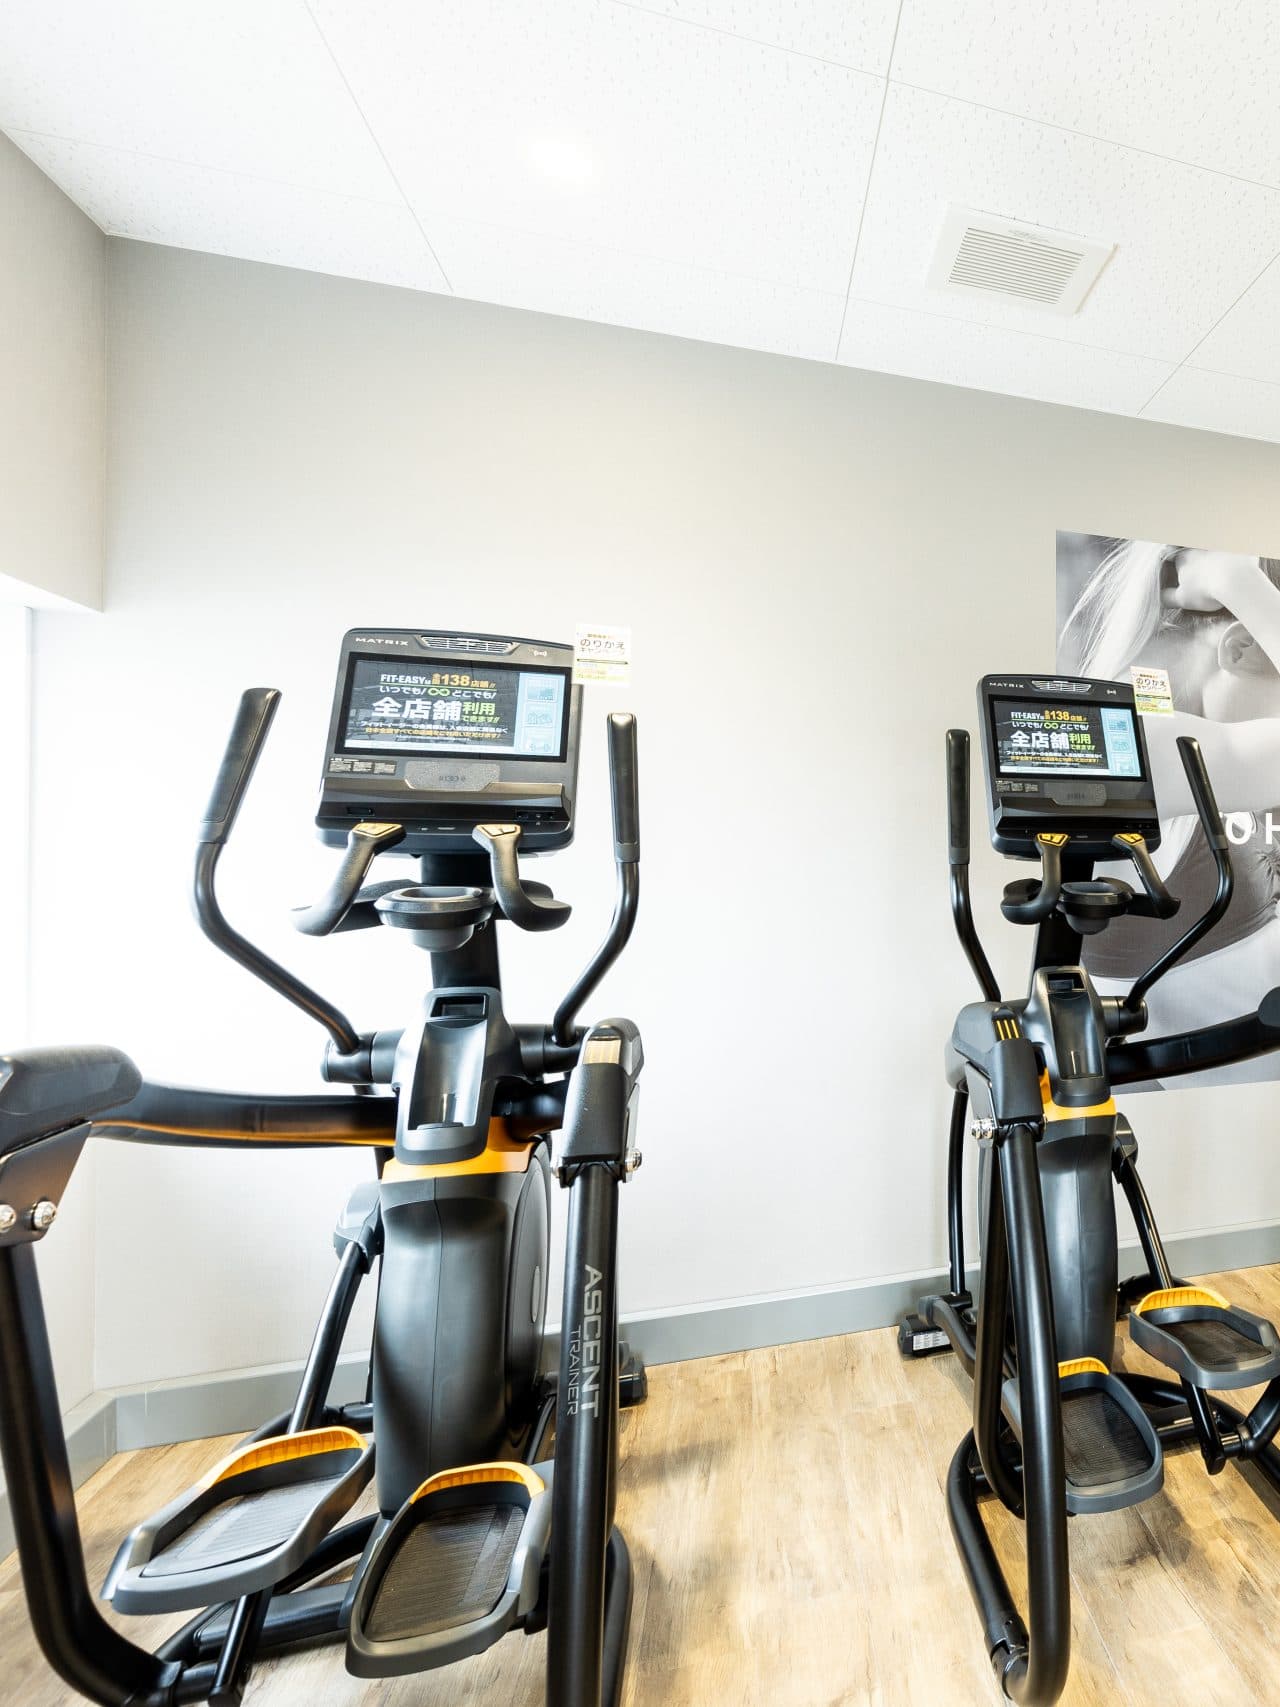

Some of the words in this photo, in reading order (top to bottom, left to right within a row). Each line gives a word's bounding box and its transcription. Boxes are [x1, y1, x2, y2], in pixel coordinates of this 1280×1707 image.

[355, 637, 409, 646] MATRIX
[567, 1324, 582, 1417] TRAINER
[580, 1264, 603, 1418] ASCENT
